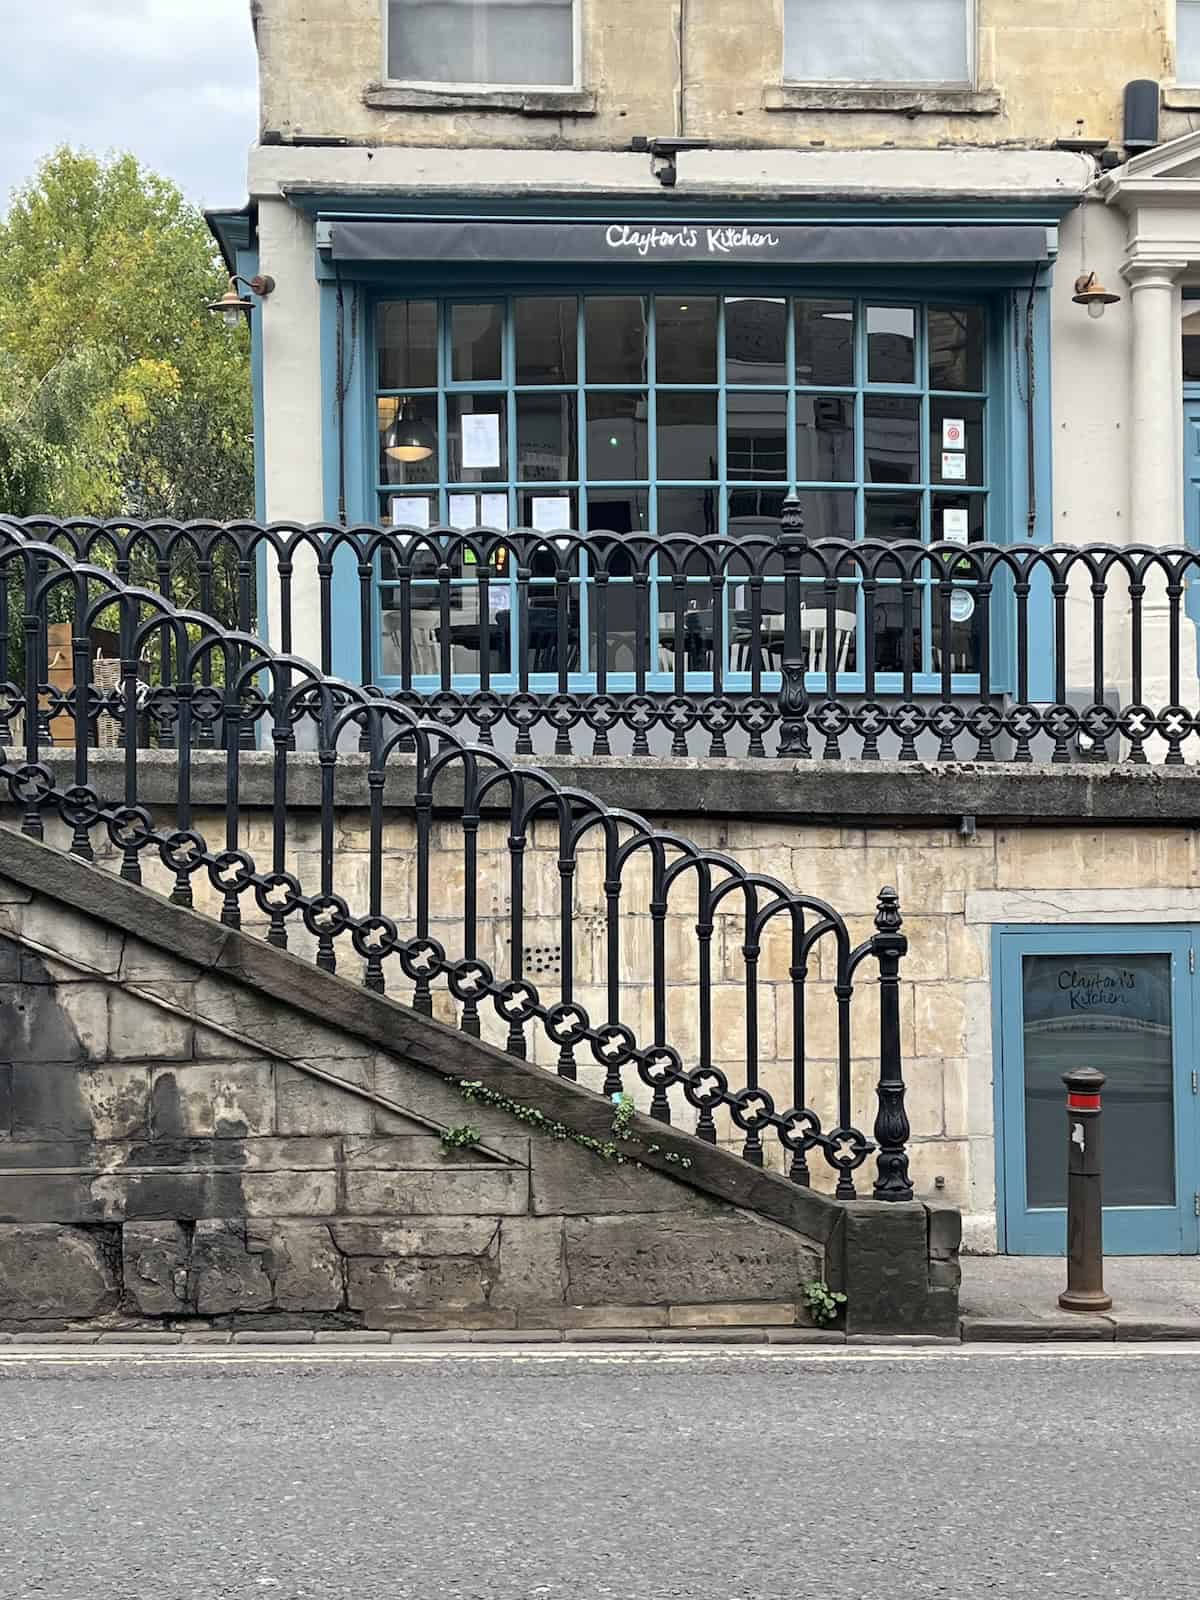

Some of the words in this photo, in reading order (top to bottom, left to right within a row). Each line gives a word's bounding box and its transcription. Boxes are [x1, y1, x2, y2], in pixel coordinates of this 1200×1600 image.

[606, 225, 697, 255] Clayton's
[707, 228, 779, 252] Kitchen
[1057, 970, 1136, 994] Clayton's
[1070, 990, 1128, 1010] Kitchen
